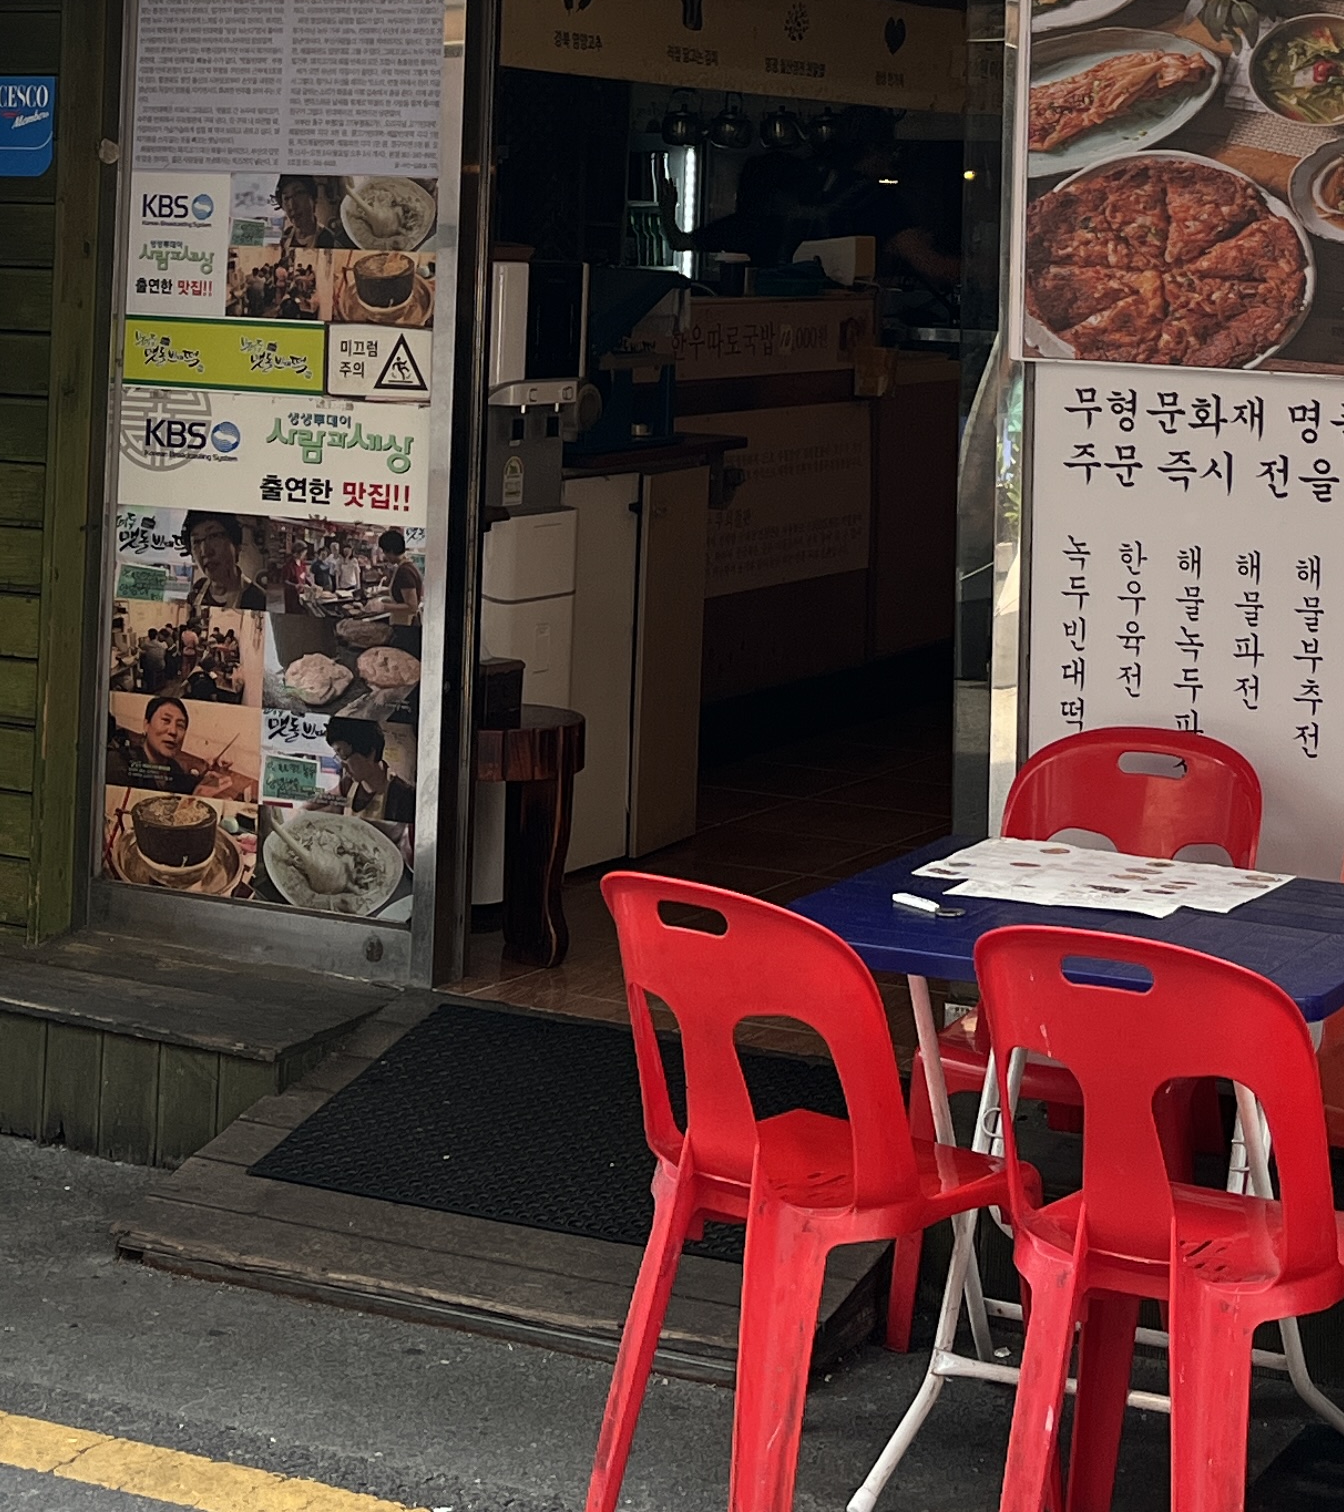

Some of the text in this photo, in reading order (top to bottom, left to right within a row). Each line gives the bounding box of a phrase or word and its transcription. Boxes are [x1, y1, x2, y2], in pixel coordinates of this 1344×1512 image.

[142, 193, 189, 219] KBS
[135, 277, 213, 297] 출연한 맛집!!
[339, 361, 365, 379] 주의
[340, 339, 378, 358] 미끄럼
[145, 418, 207, 450] KBS
[287, 412, 352, 429] 생생투데이
[1064, 387, 1264, 442] 무형문화재
[259, 474, 410, 512] 출연한 맛집!!
[1063, 443, 1144, 487] 주문
[1157, 450, 1233, 497] 즉시
[1256, 454, 1340, 503] 전을
[1060, 534, 1091, 733] 녹두빈대떡
[1116, 540, 1148, 700] 한우육전
[1233, 549, 1265, 711] 해물파전
[1173, 545, 1205, 774] 해물녹두파
[1292, 554, 1325, 759] 해물부추전
